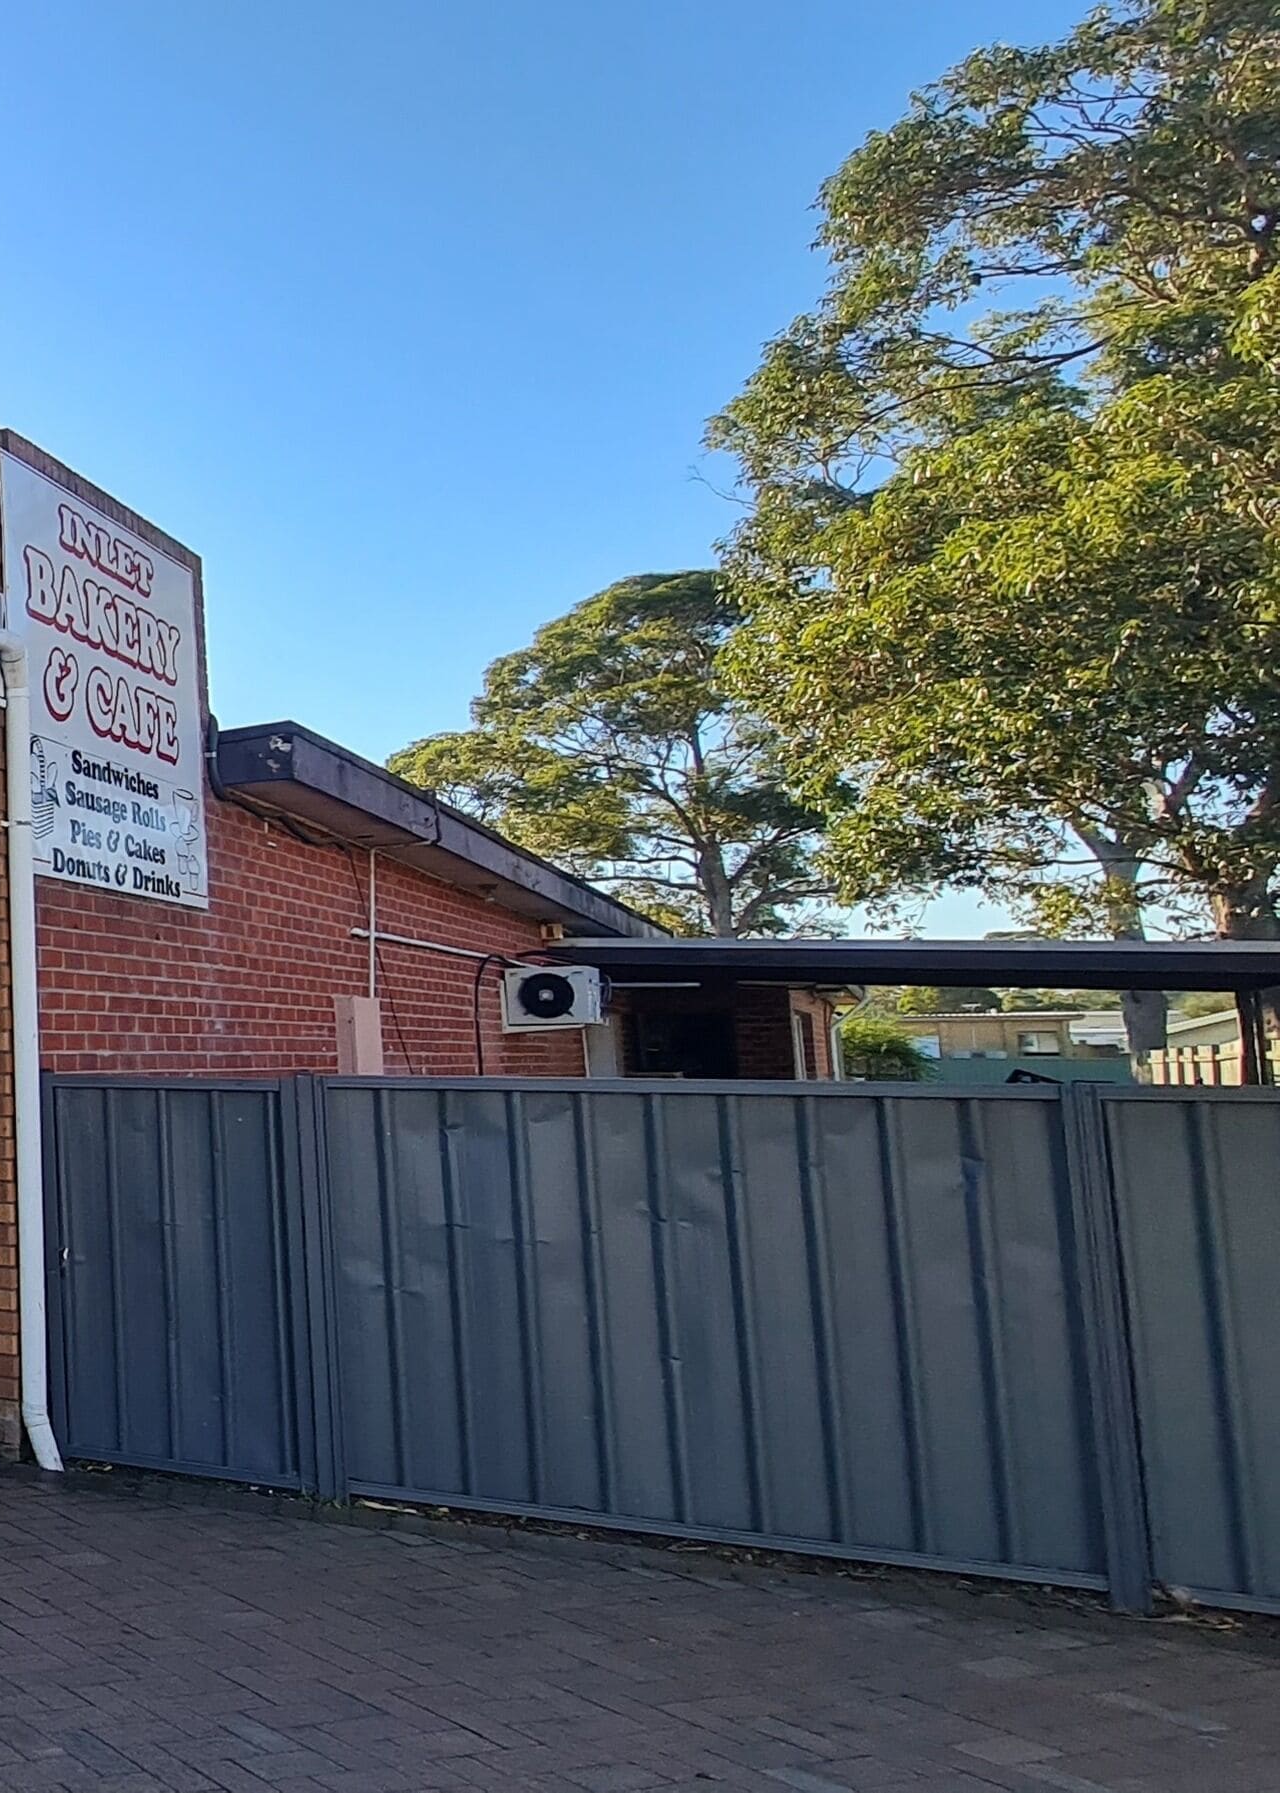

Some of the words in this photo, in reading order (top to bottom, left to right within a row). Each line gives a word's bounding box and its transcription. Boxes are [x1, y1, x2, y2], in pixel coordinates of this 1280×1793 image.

[58, 503, 154, 597] INLET
[24, 544, 180, 686] BAKERY
[44, 646, 79, 722] &
[85, 665, 180, 766] CAFE
[71, 749, 159, 800] Sandwiches
[65, 780, 128, 824] Sausage
[131, 801, 167, 833] Rolls
[69, 818, 102, 850] Pies
[106, 829, 121, 853] &
[124, 833, 166, 866] Cakes
[51, 847, 111, 884] Donuts
[114, 862, 128, 887] &
[132, 866, 181, 899] Drinks
